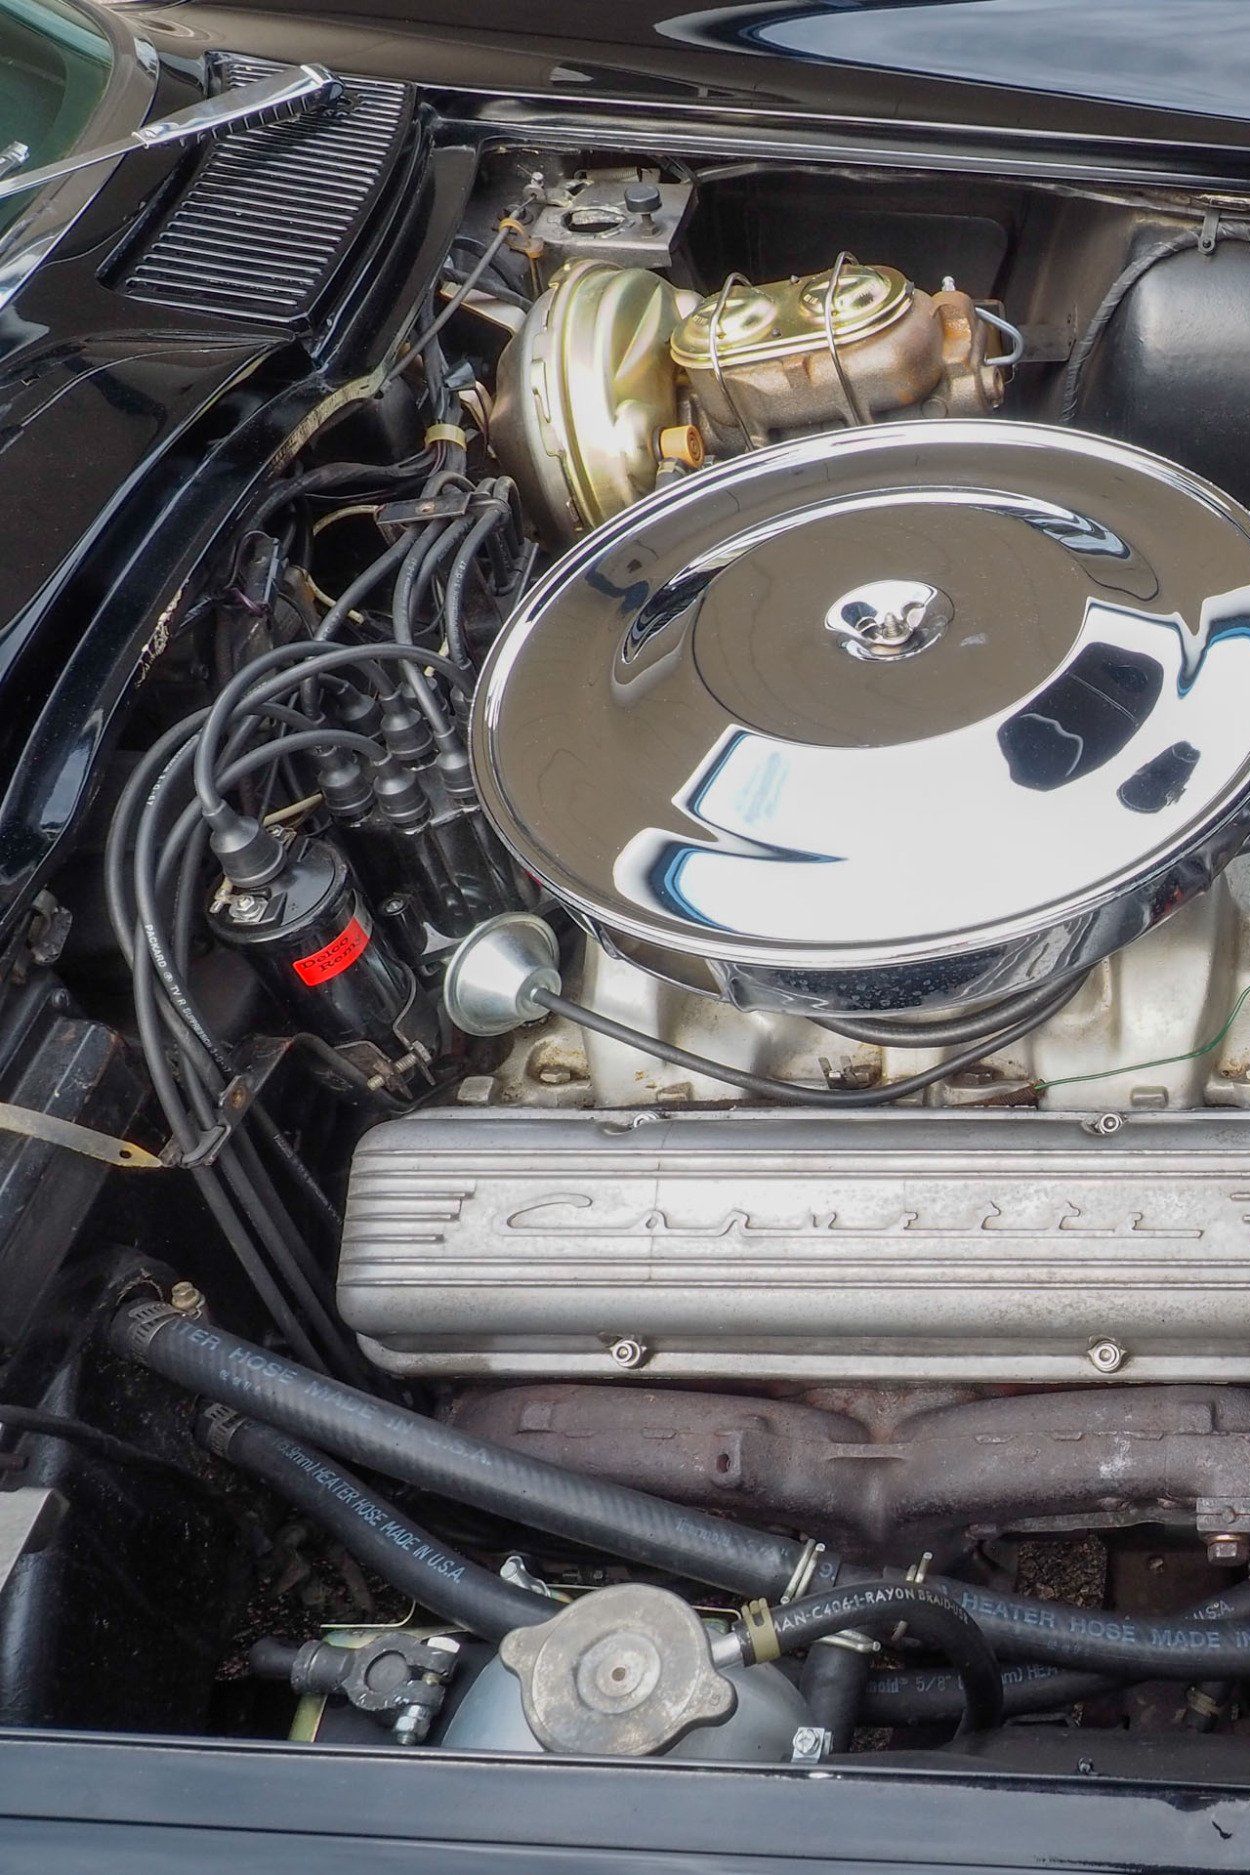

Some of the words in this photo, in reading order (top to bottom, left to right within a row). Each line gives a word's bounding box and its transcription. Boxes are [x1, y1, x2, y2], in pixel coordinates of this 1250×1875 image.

[144, 923, 168, 968] PACKARD
[170, 984, 182, 996] TV
[228, 1346, 299, 1385] HOSE
[311, 1465, 361, 1505] HEATER
[352, 1498, 389, 1527] HOSE
[379, 1519, 421, 1551] MADE
[412, 1544, 433, 1561] IN
[426, 1552, 468, 1584] U.S.A.
[960, 1590, 1056, 1629] HEATER
[1069, 1615, 1137, 1643] HOSE
[1150, 1627, 1222, 1649] MADE
